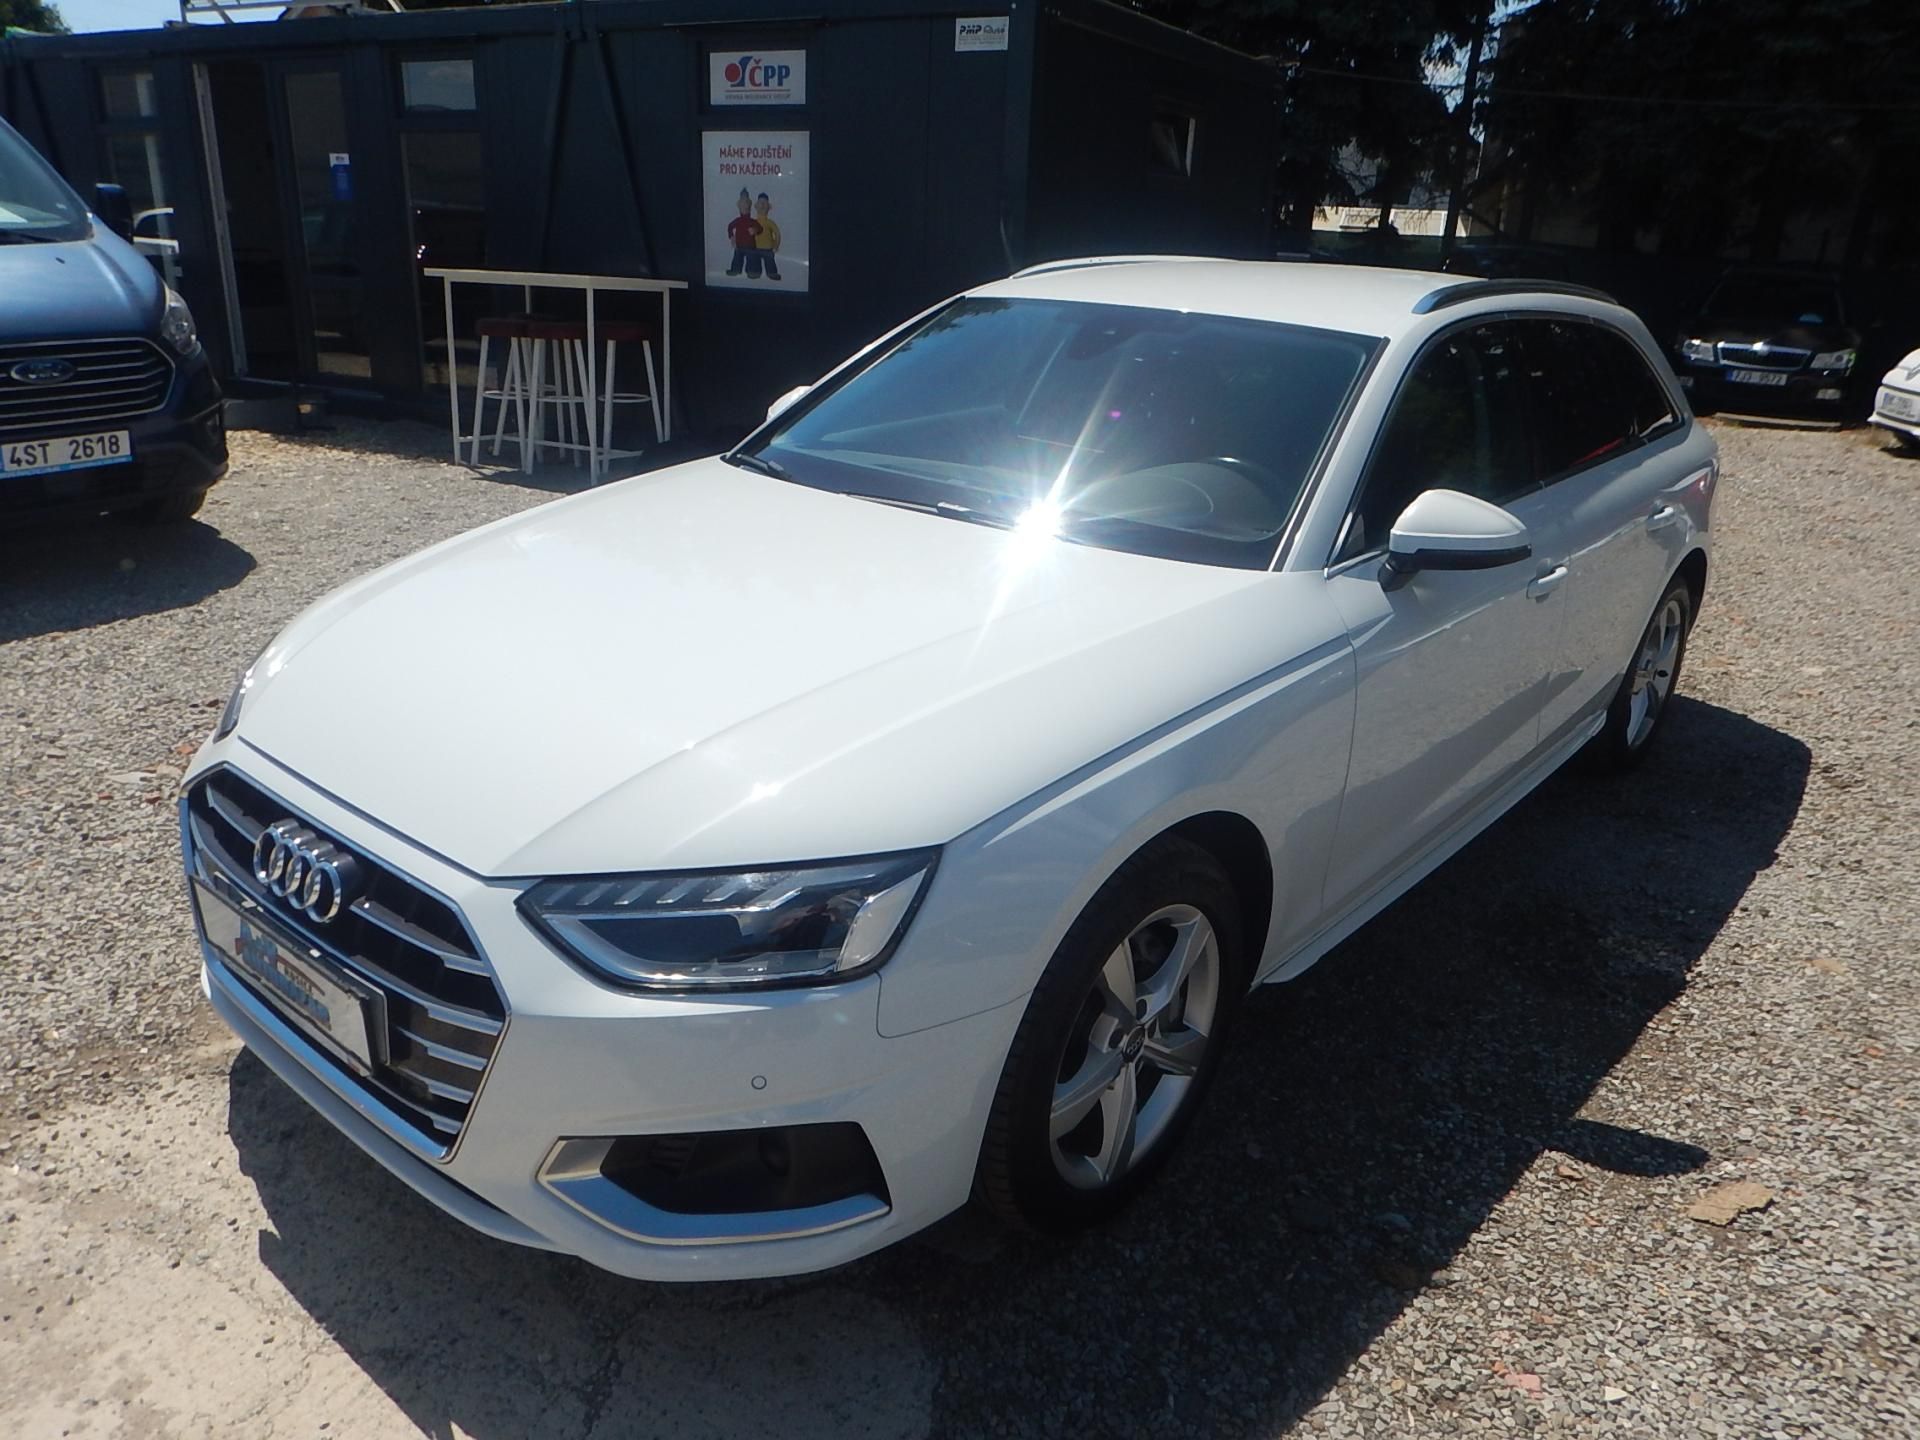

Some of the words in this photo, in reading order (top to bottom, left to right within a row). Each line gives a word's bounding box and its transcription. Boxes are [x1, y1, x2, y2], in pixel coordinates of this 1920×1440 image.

[749, 58, 791, 87] ČPP
[719, 144, 745, 159] MÁME
[747, 144, 792, 159] POJIŠTĚNÍ
[719, 163, 737, 175] PRO
[10, 442, 50, 467] 4ST
[69, 434, 120, 460] 2618
